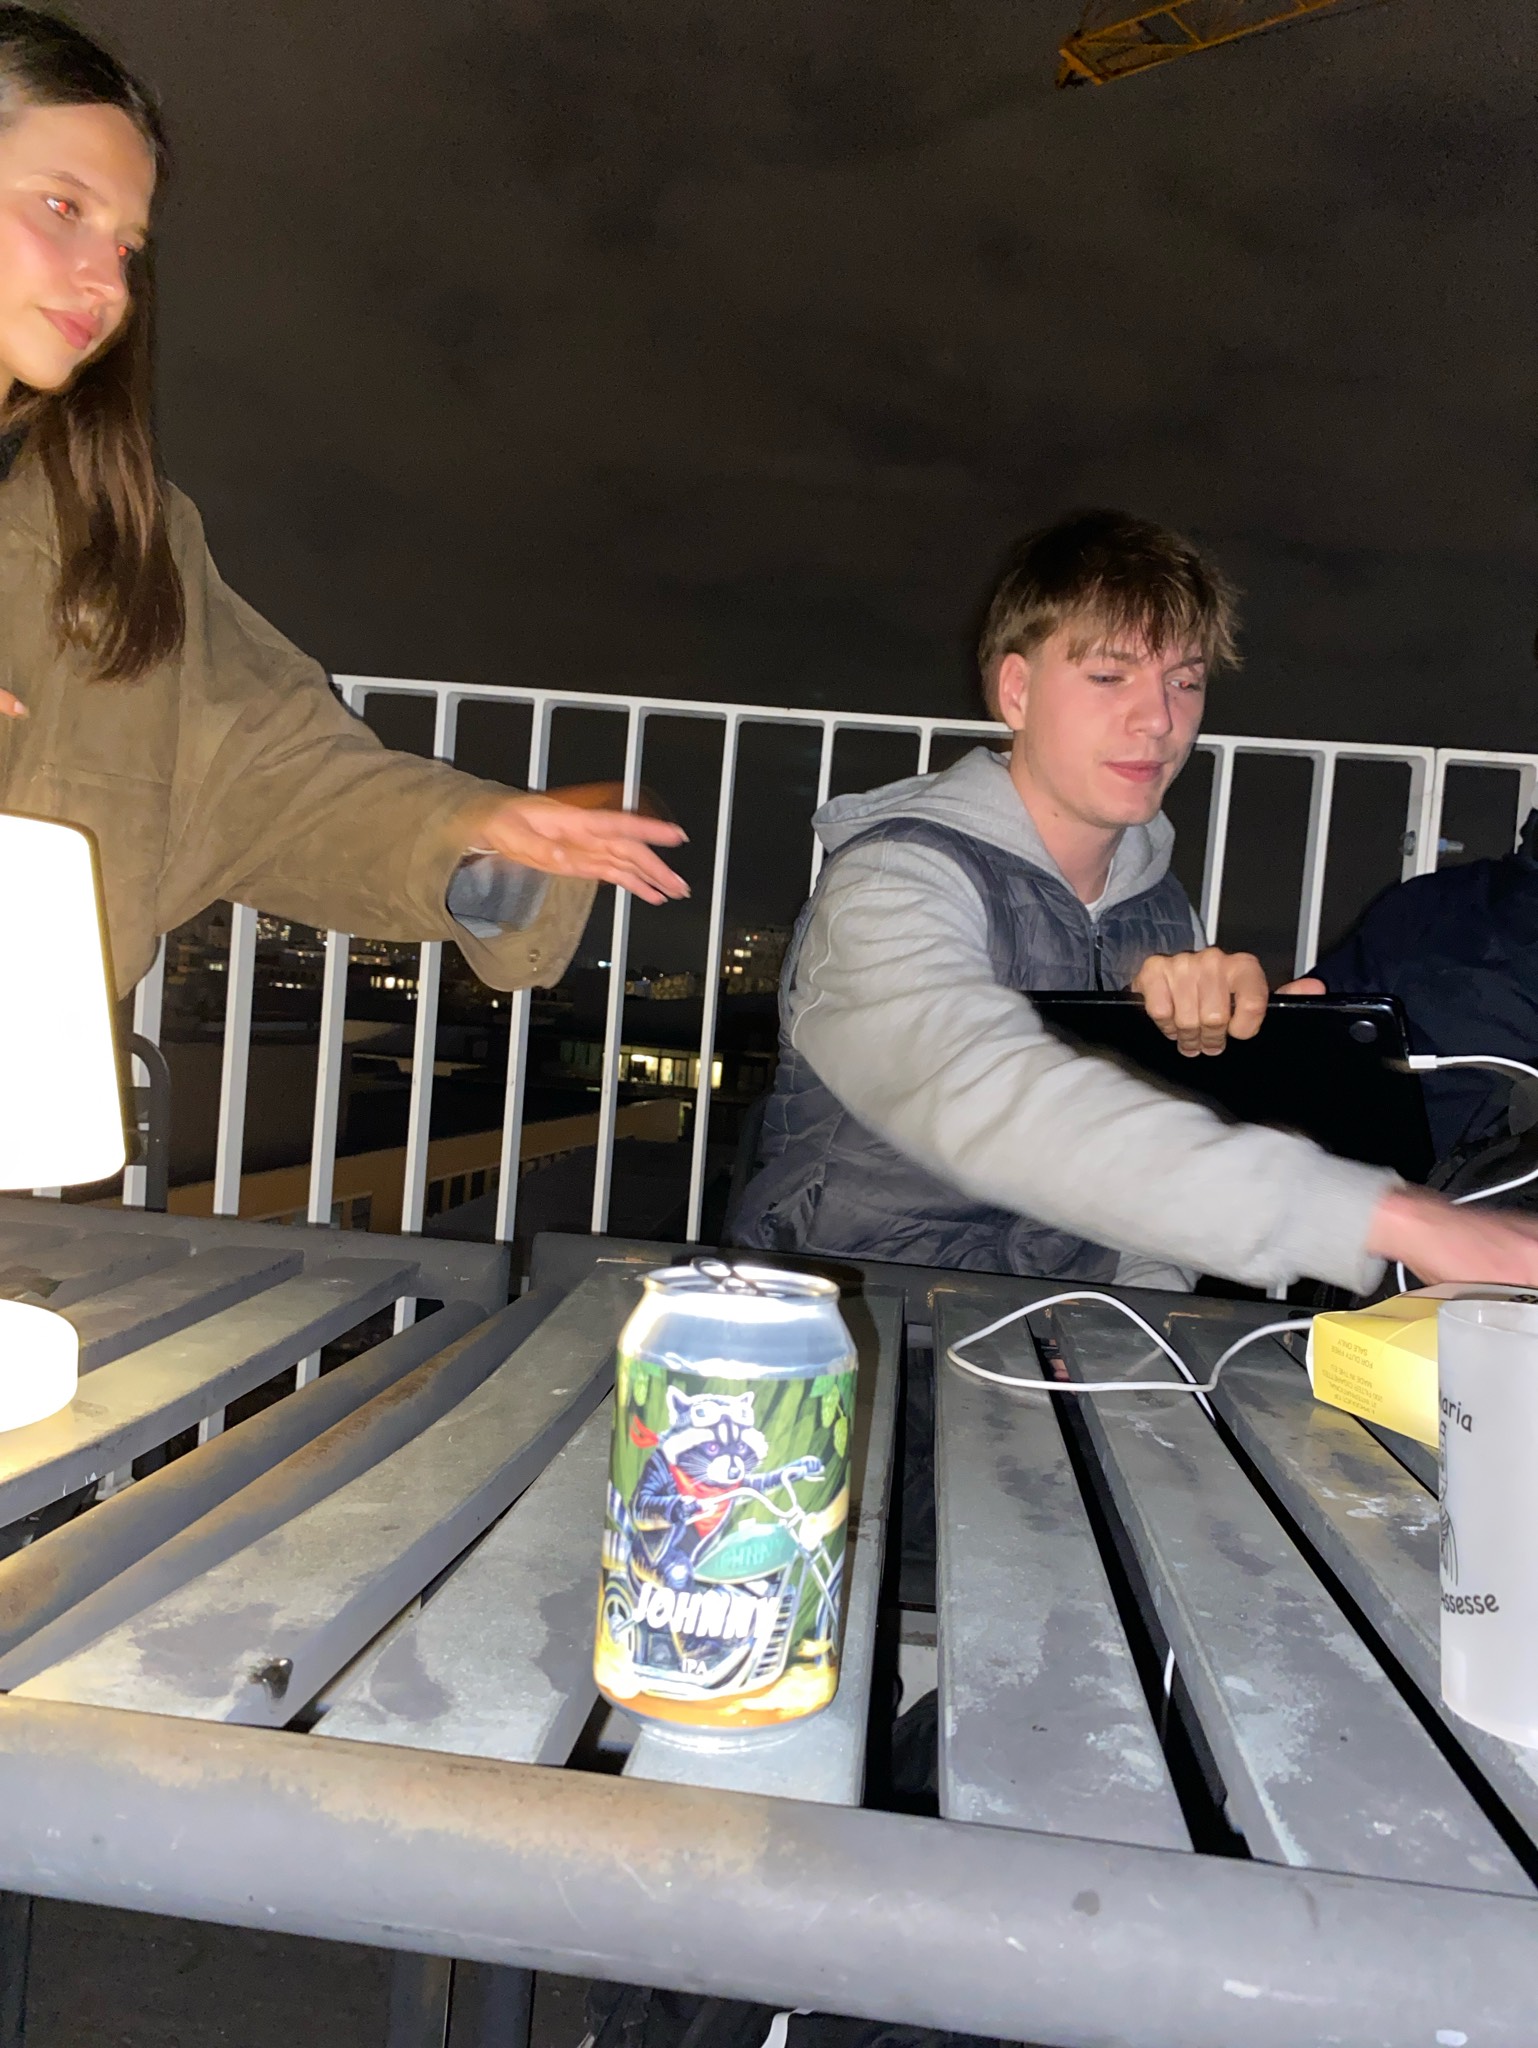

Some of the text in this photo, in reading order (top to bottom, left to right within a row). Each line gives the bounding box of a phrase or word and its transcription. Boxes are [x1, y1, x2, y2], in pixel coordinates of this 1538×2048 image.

[1438, 1387, 1472, 1433] aria
[632, 1581, 780, 1646] JOHNNY
[682, 1658, 708, 1675] IPA
